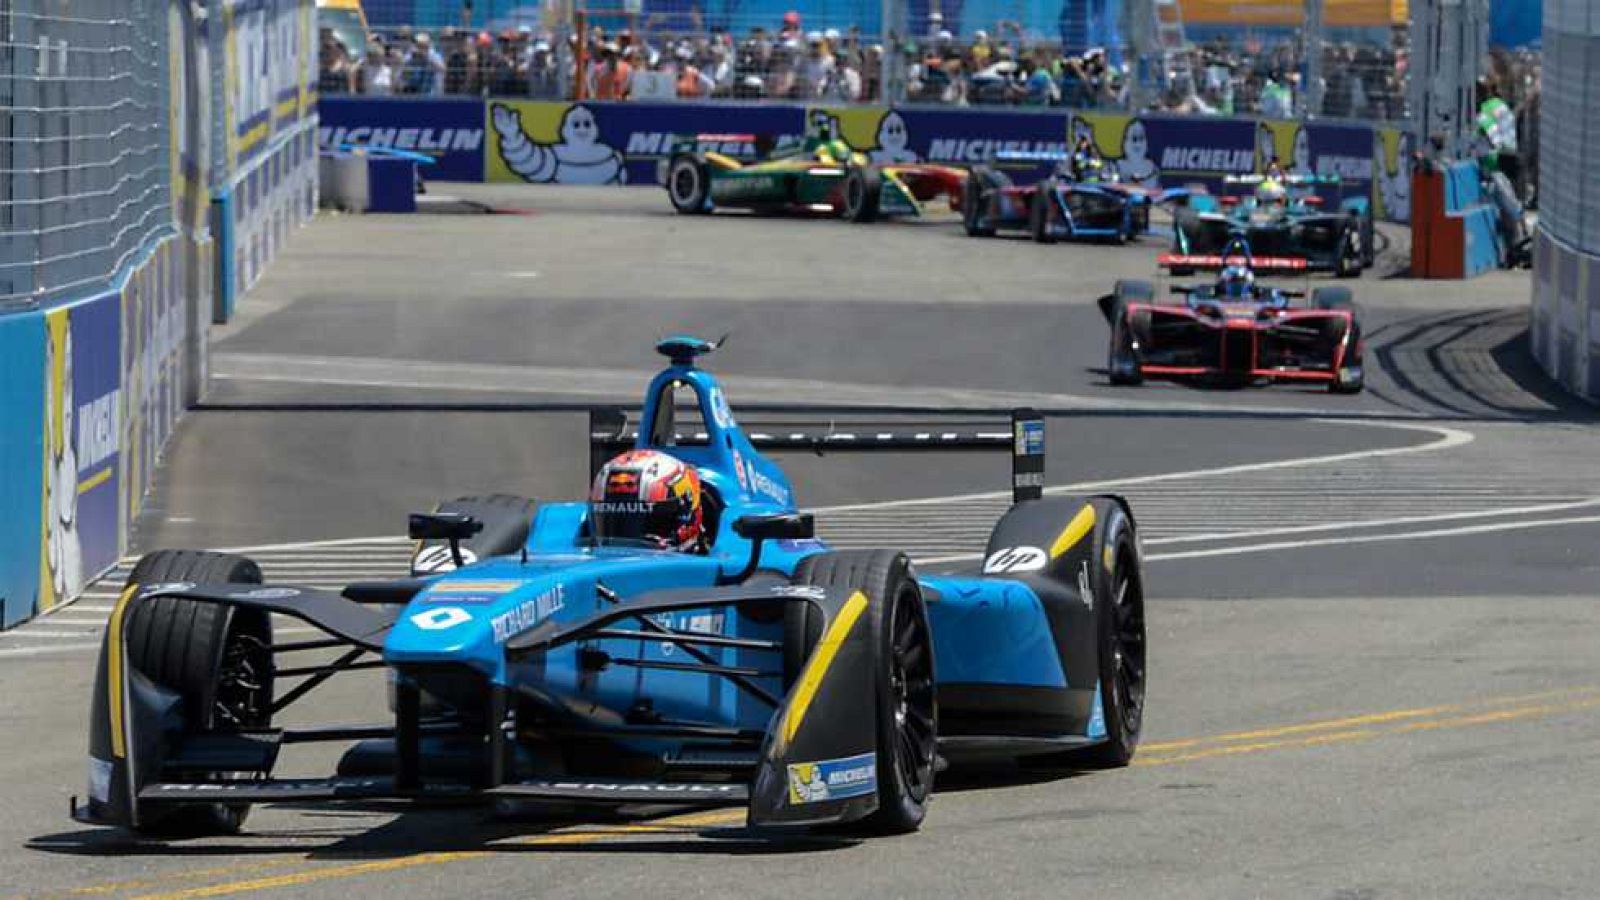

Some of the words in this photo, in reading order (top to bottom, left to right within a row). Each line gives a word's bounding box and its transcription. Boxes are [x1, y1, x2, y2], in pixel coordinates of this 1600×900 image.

[1160, 146, 1255, 171] MICHELIN
[593, 501, 654, 514] RENAULT
[991, 547, 1038, 572] hp
